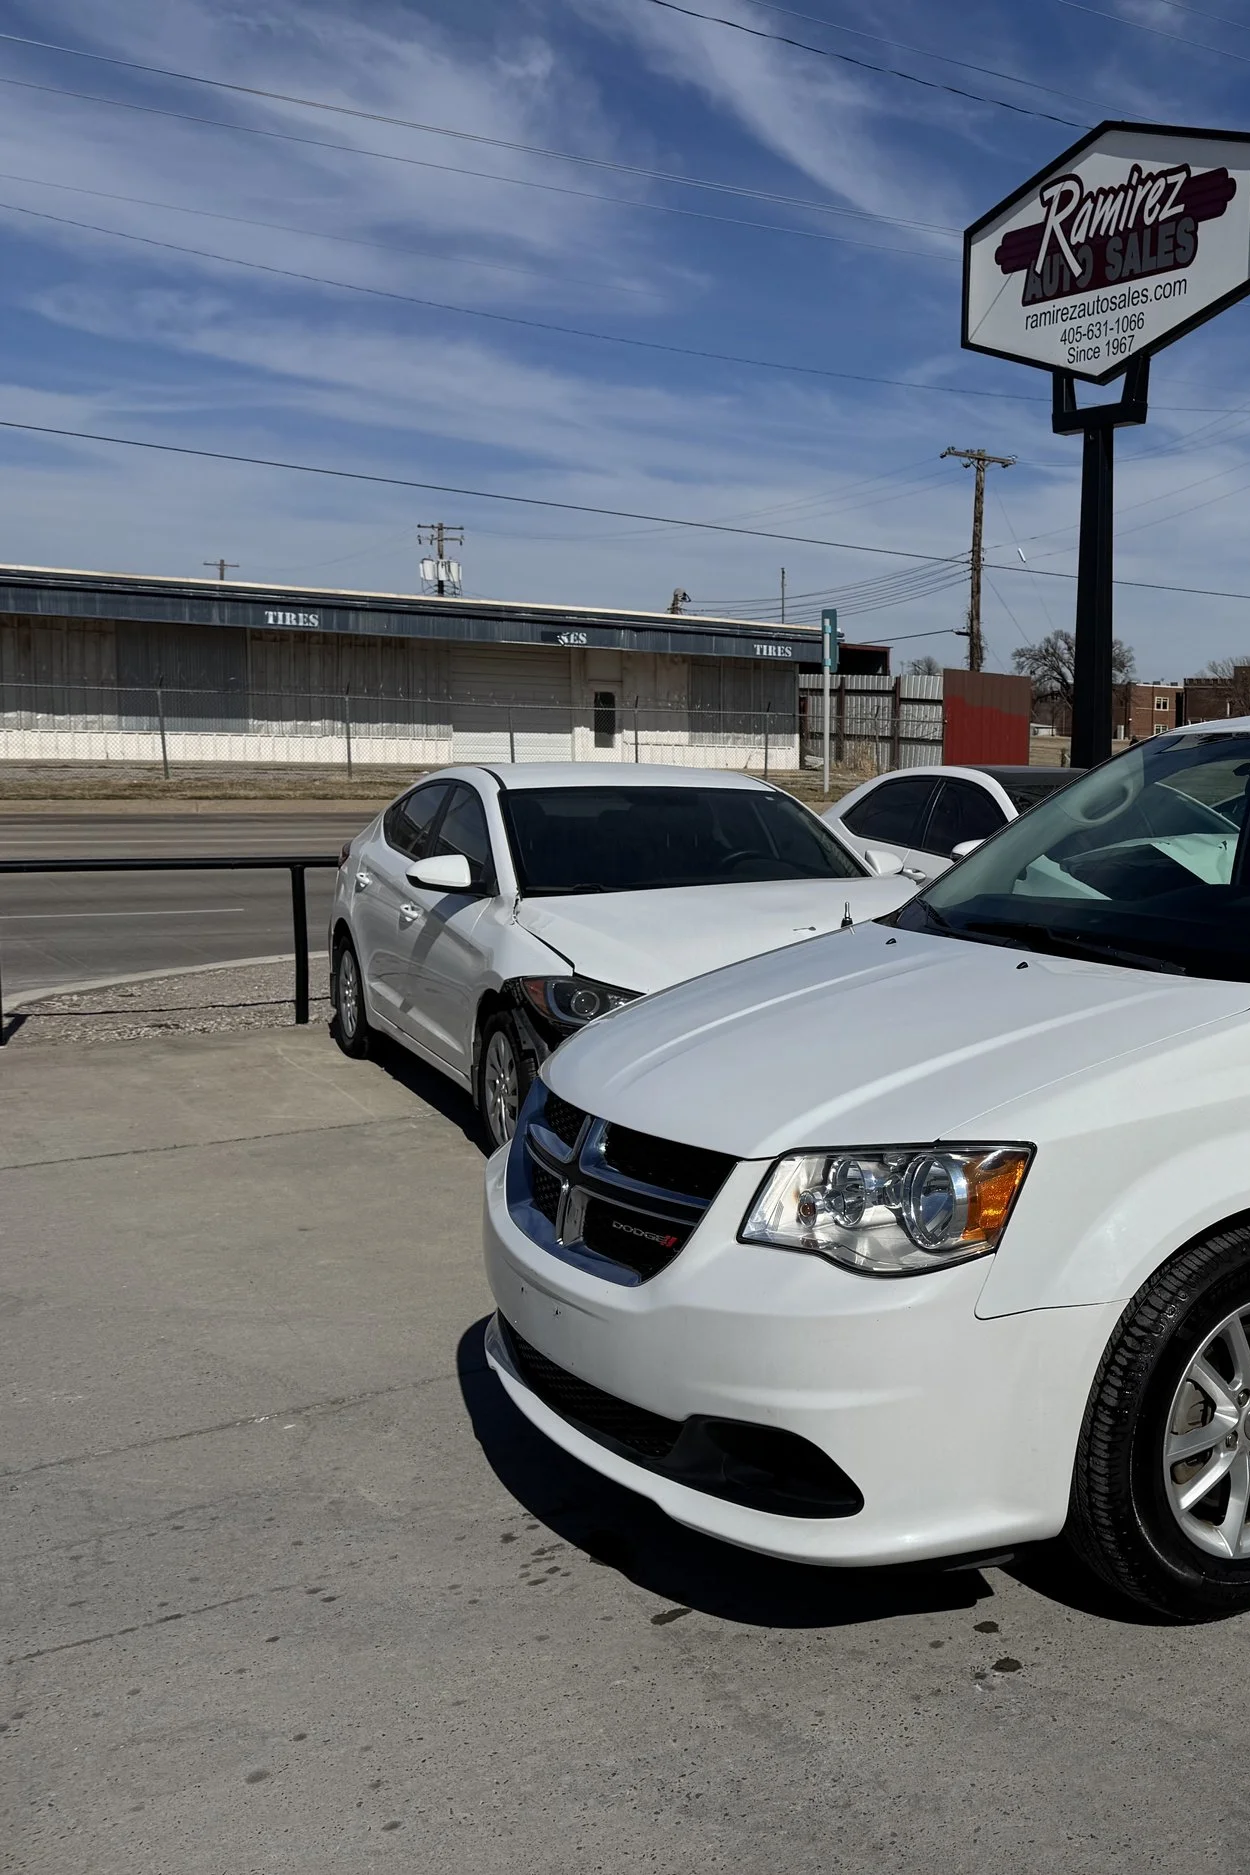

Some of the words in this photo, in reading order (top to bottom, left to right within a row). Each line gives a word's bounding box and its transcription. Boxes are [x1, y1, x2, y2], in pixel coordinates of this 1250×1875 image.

[1035, 171, 1187, 278] Ramirez
[1025, 245, 1093, 300] AUTO
[1104, 216, 1195, 281] SALES
[1025, 278, 1187, 330] ramirezautosales.com
[1060, 312, 1145, 345] 405-631-1066
[1067, 346, 1100, 364] Since
[1105, 335, 1135, 357] 1967
[265, 611, 319, 626] TIRES
[753, 644, 792, 657] TIRES
[612, 1221, 668, 1243] DODGE
